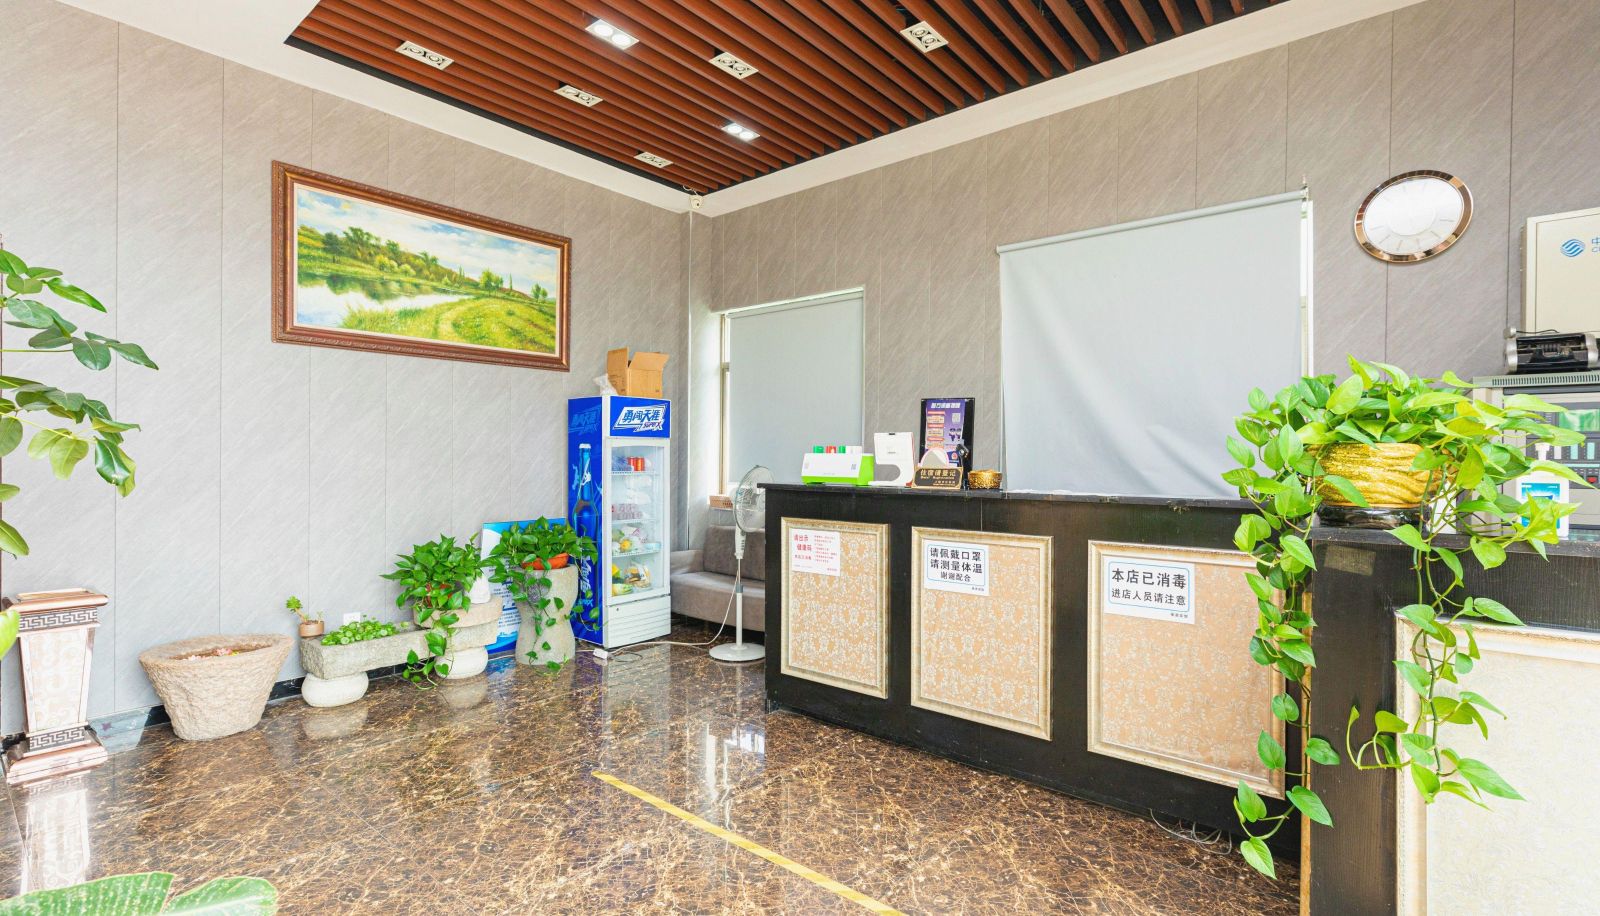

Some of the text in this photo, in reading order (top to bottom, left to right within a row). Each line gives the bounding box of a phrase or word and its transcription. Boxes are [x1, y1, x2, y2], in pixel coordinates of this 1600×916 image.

[622, 409, 661, 424] 勇闯天涯
[930, 547, 982, 562] 请佩戴口罩
[930, 558, 983, 574] 请测量体温
[940, 571, 971, 582] 谢谢配合
[1111, 567, 1187, 590] 本店已消毒
[1111, 588, 1187, 606] 进店人员请注意
